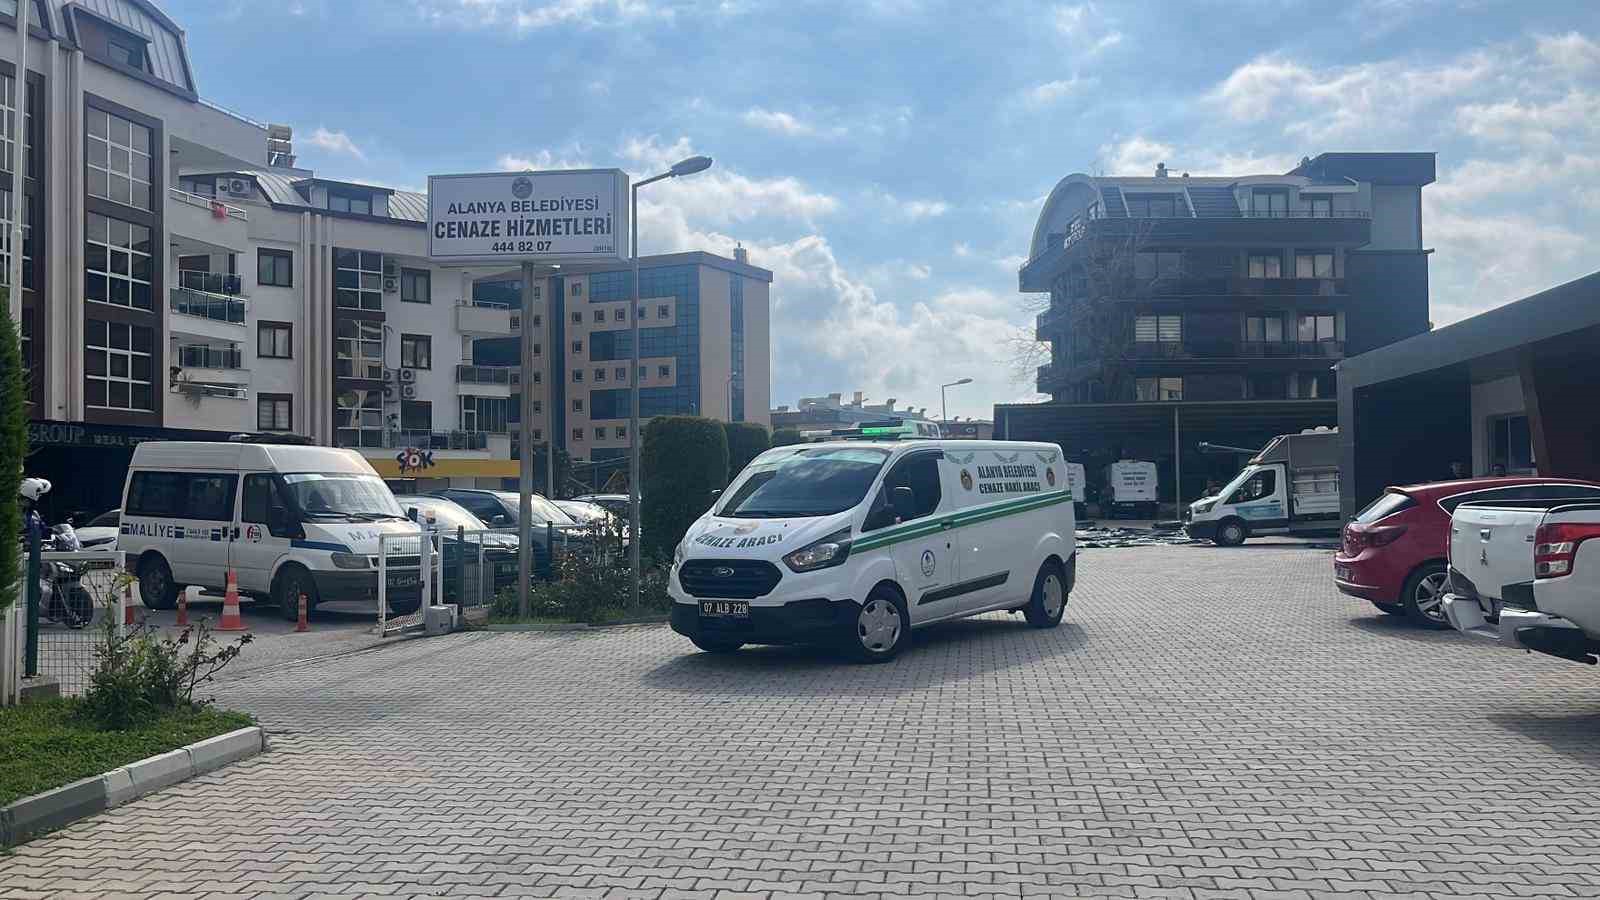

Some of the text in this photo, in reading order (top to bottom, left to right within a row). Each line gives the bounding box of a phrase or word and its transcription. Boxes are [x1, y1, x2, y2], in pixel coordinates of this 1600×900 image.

[447, 195, 599, 215] ALANYA BELEDİYESİ
[434, 213, 612, 239] CENAZE HİZMETLERİ
[492, 241, 551, 252] 444 82 07
[977, 465, 1003, 479] ALANYA
[979, 482, 1004, 494] CENAZE
[129, 522, 174, 538] MALİYE
[695, 533, 783, 548] CENAZE ARACI
[703, 603, 747, 614] 07 ALB 228
